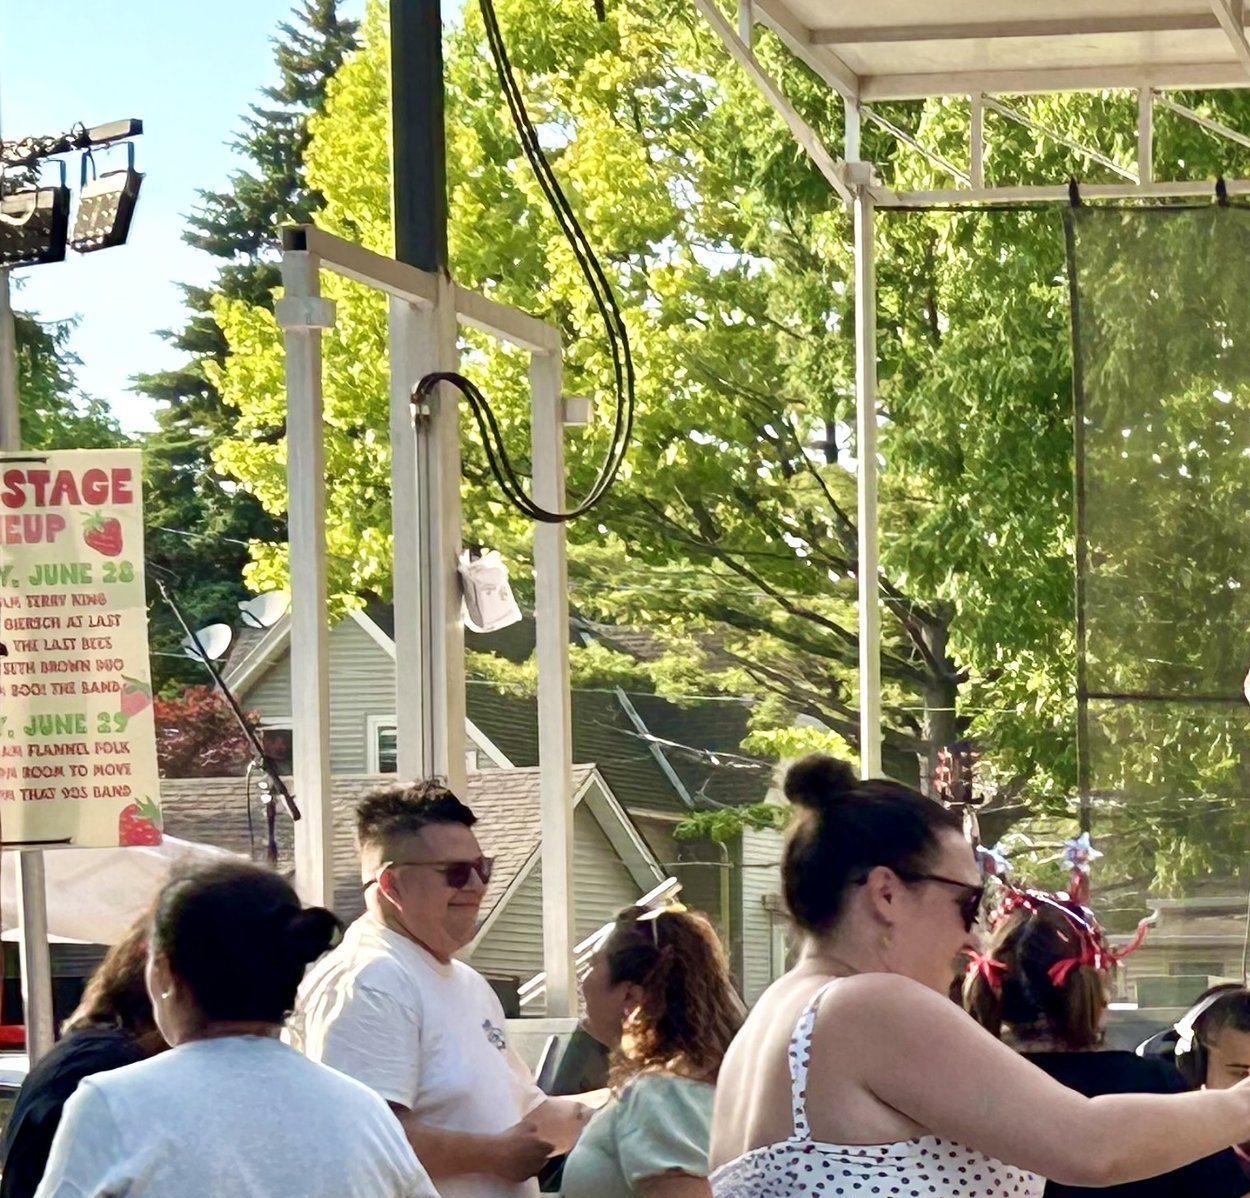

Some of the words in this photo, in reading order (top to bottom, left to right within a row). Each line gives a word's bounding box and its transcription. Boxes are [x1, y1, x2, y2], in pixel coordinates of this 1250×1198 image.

[1, 467, 134, 510] STAGE
[0, 513, 66, 545] EUP
[29, 563, 93, 586] JUNE
[102, 560, 135, 584] 28
[25, 594, 67, 608] TERRY
[66, 615, 83, 628] AT
[89, 614, 121, 628] LAST
[13, 639, 39, 652] THE
[43, 637, 76, 651] LAST
[81, 636, 113, 651] BEES
[3, 661, 35, 674] SETH
[40, 659, 91, 673] BROWN
[51, 681, 76, 695] THE
[81, 680, 120, 694] BAND
[23, 712, 88, 737] JUNE
[97, 711, 129, 735] 29
[28, 742, 90, 758] FLANNEL
[95, 741, 131, 755] FOLK
[22, 764, 64, 779] ROOM
[69, 764, 88, 777] TO
[93, 762, 132, 777] MOVE
[20, 787, 56, 802] THAT
[93, 784, 132, 798] BAND
